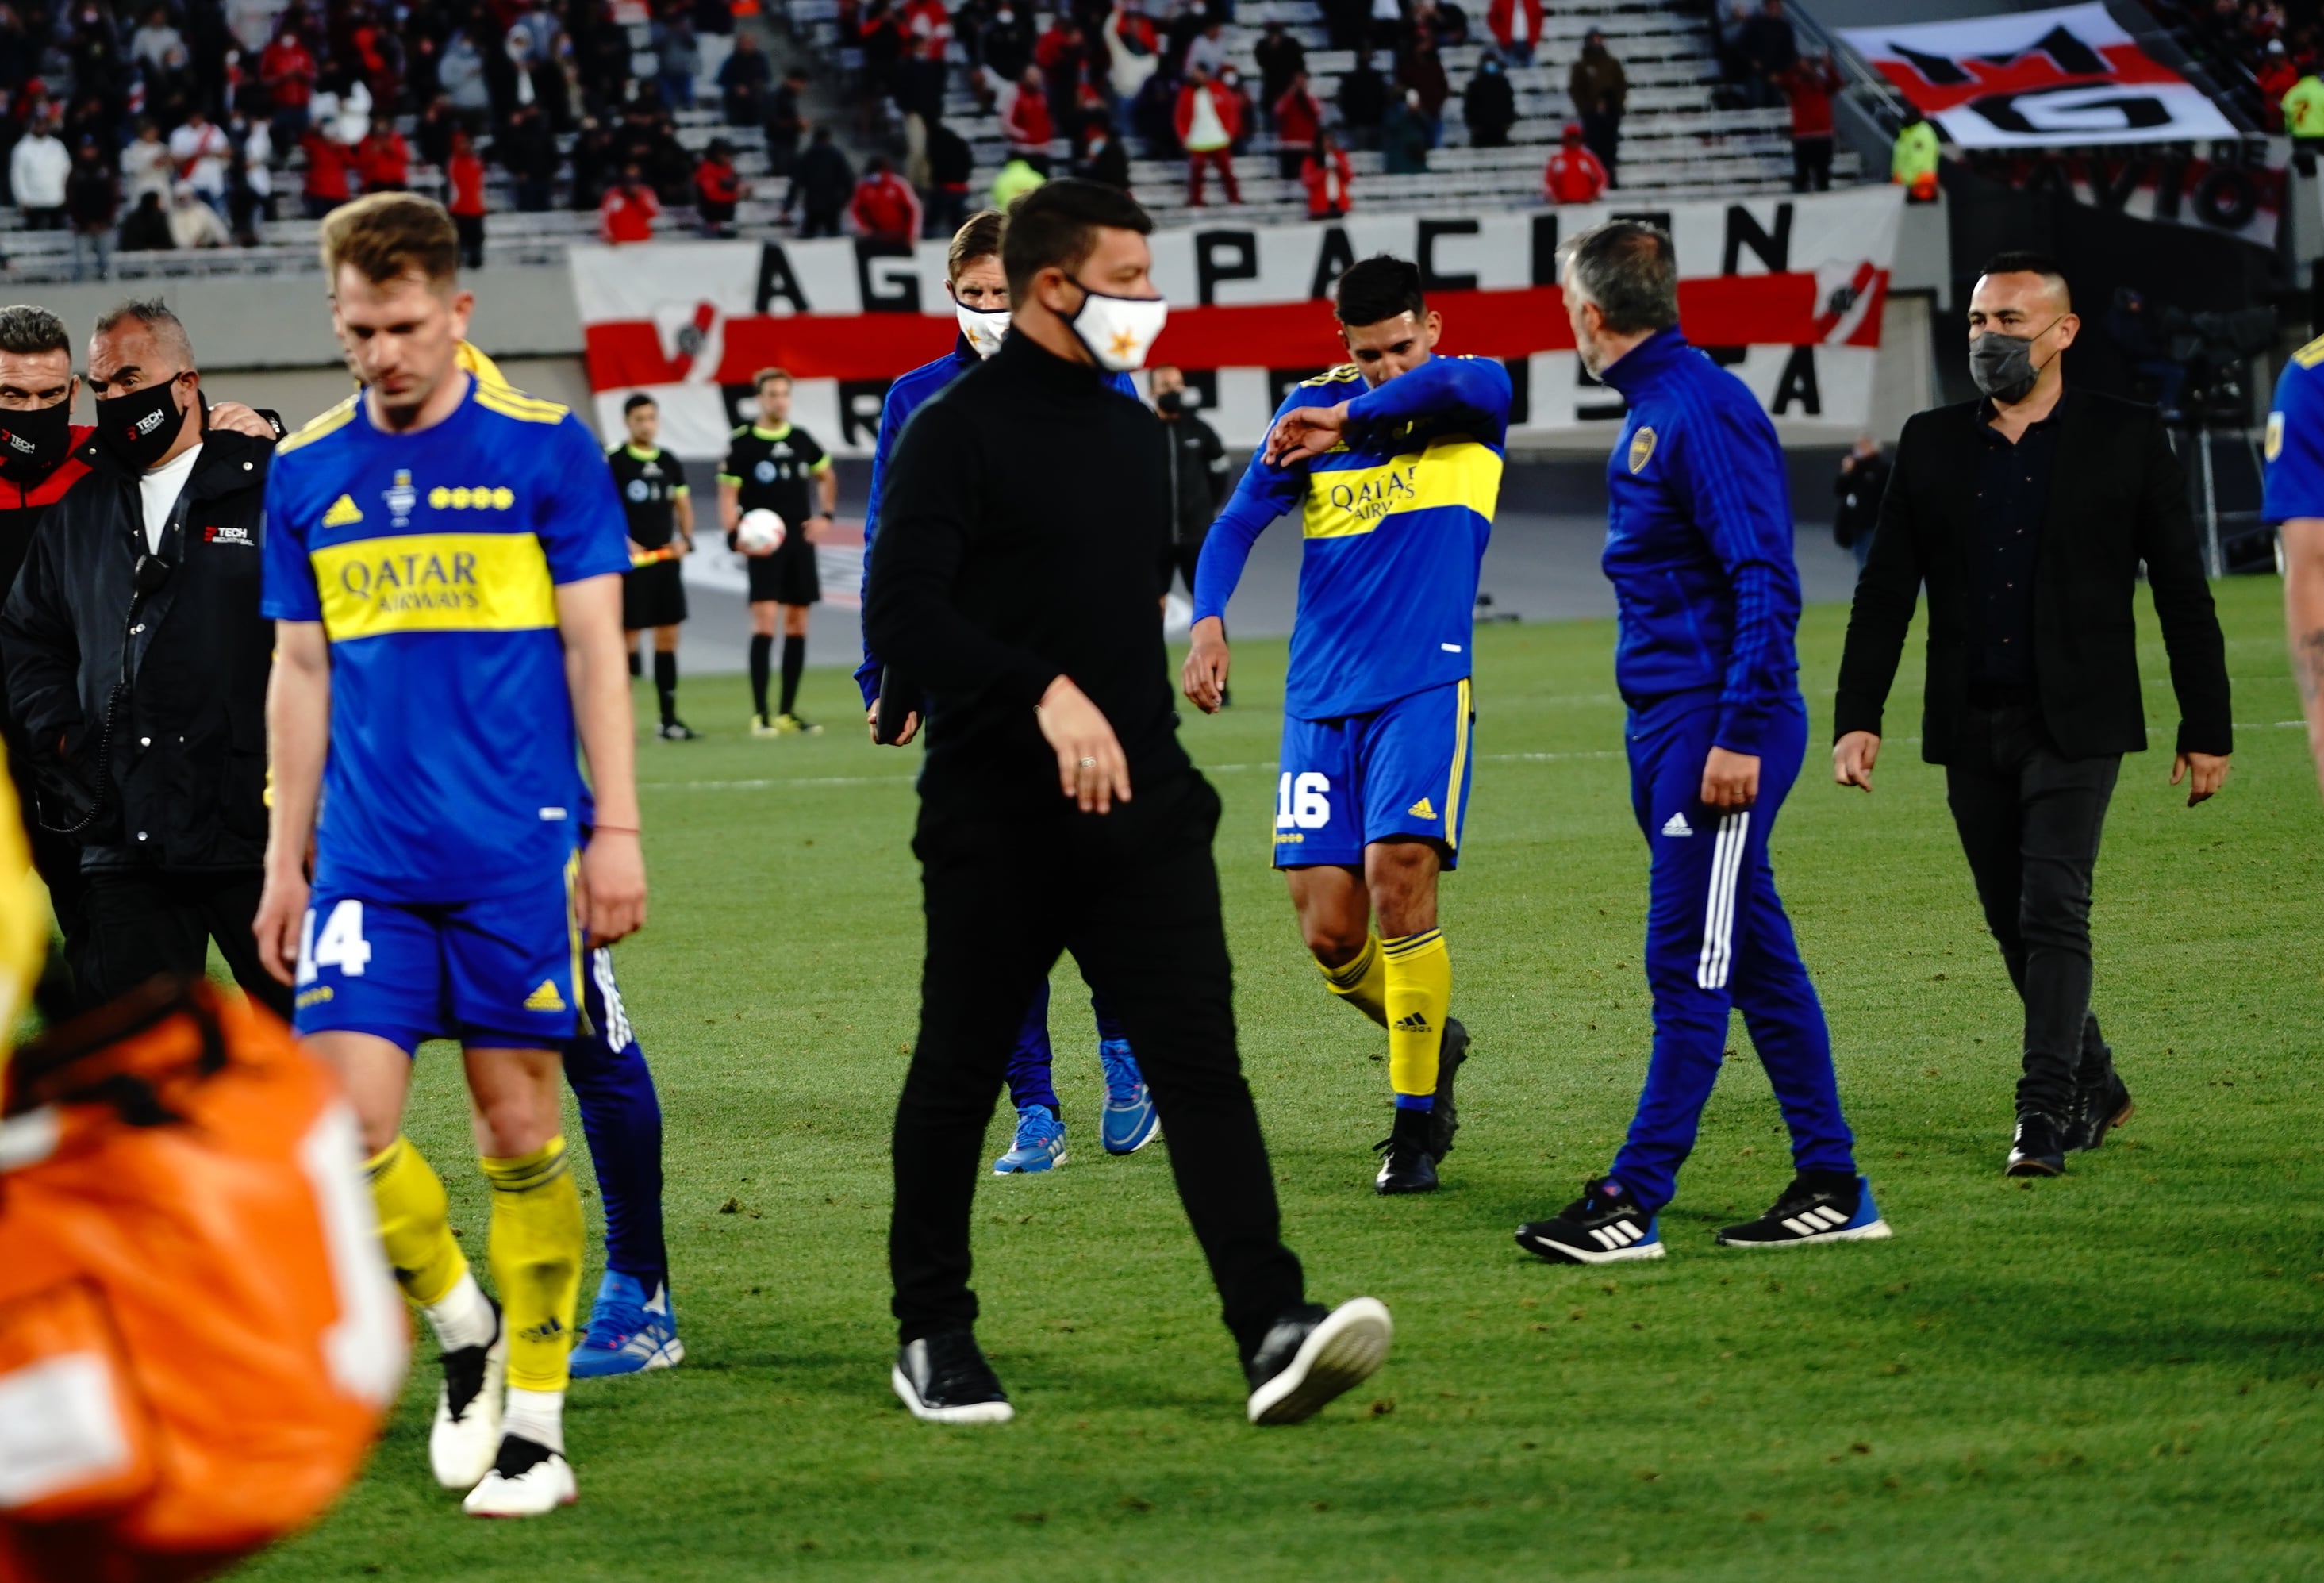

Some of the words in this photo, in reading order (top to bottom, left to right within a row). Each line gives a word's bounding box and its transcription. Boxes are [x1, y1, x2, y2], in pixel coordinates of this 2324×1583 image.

[136, 409, 164, 430] TECH
[10, 433, 36, 451] TECH
[217, 527, 248, 539] TECH
[341, 551, 478, 601] QATAR
[378, 590, 480, 613] AIRWAYS
[1277, 772, 1330, 828] 16
[296, 899, 372, 987] 14
